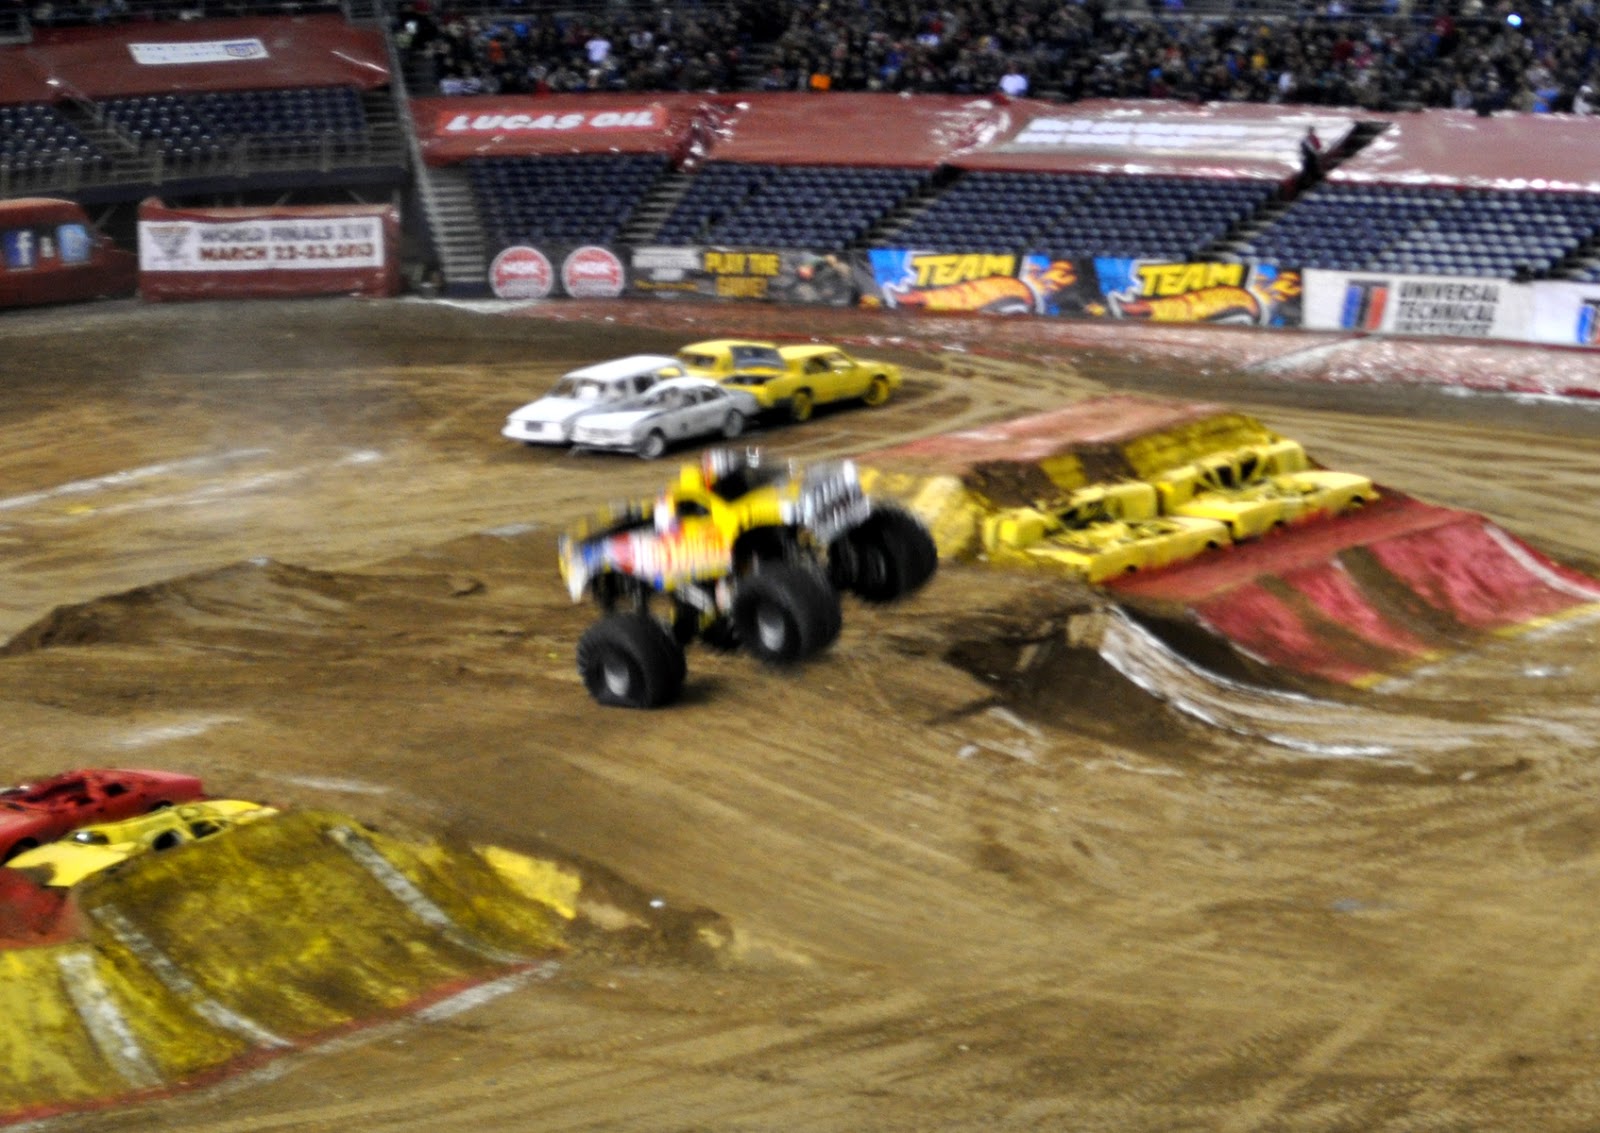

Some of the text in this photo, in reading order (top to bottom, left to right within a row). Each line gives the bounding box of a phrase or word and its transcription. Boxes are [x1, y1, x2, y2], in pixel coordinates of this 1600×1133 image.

[445, 111, 654, 131] LUCAS OIL
[200, 227, 265, 243] WORLD
[200, 245, 266, 262] MARCH
[911, 253, 1016, 287] TEAM
[1138, 262, 1243, 297] TEAM
[1398, 281, 1499, 304] UNIVERSAL
[1396, 300, 1494, 322] TECHNICAL
